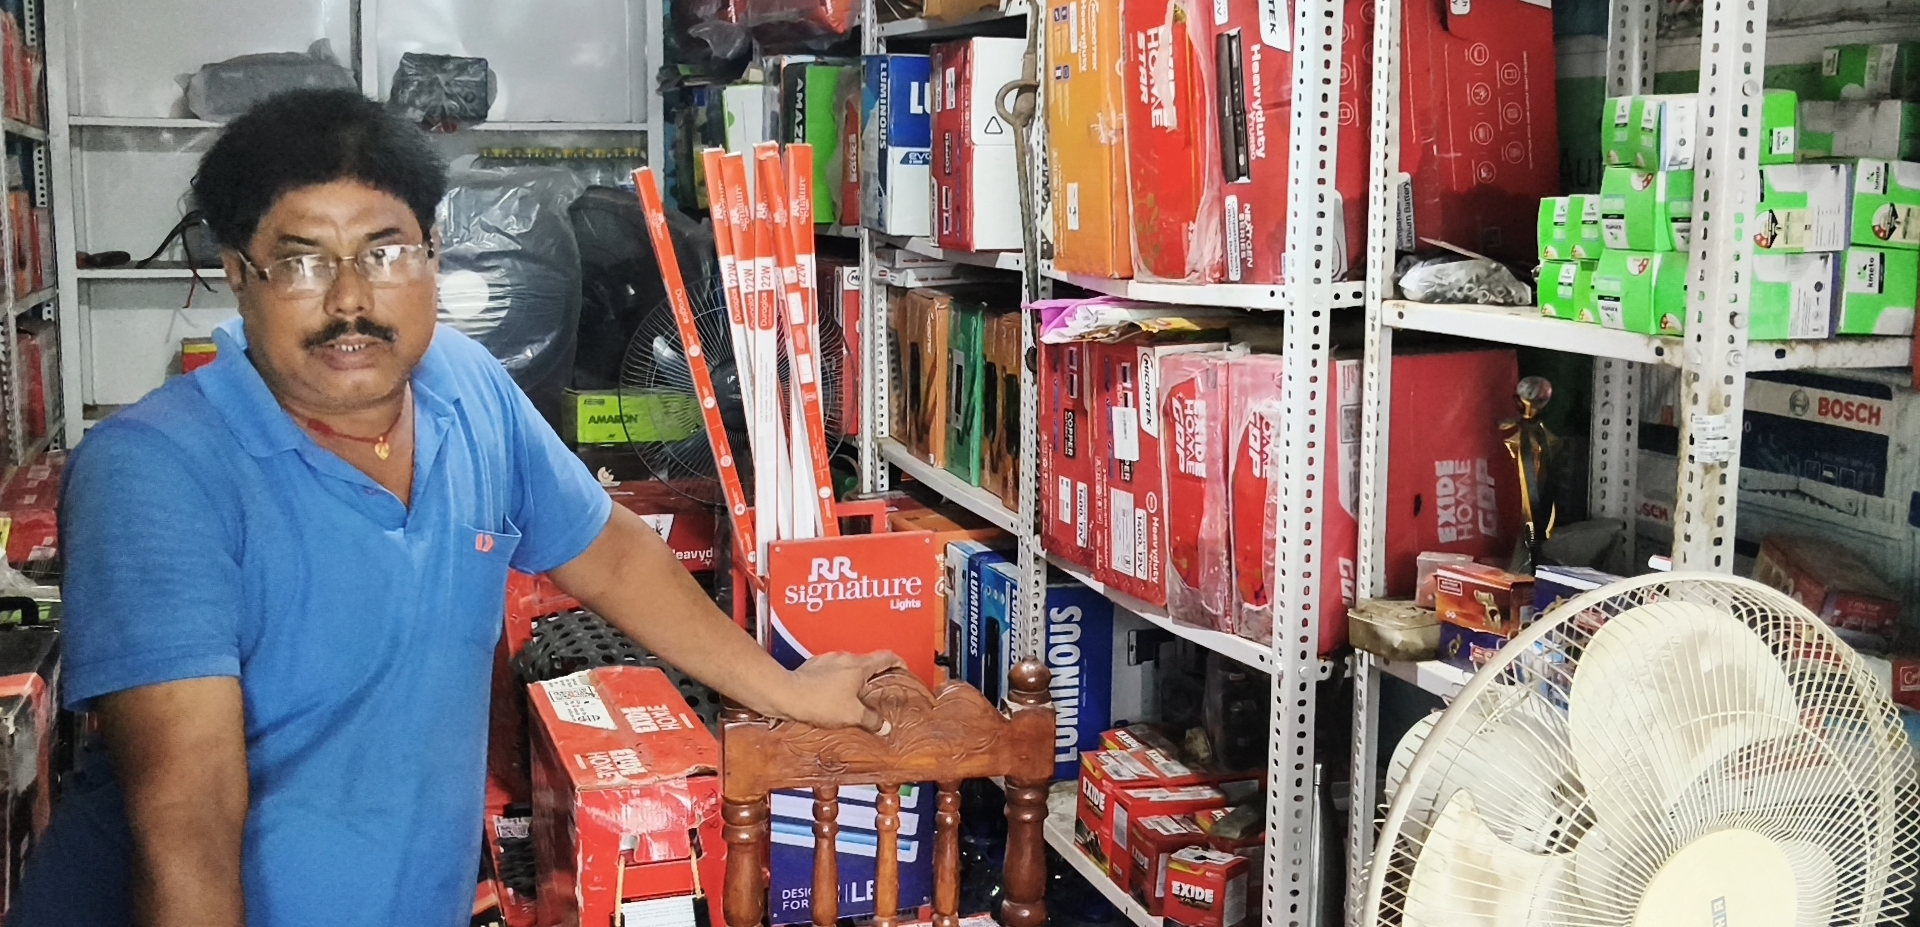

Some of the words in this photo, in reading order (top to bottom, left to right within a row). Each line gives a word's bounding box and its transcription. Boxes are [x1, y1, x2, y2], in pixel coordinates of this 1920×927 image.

[1137, 31, 1148, 104] STAR
[878, 62, 888, 150] LUMINOUS
[1251, 44, 1265, 159] Heavyduty
[848, 133, 858, 183] EXIDE
[798, 176, 810, 226] signature
[1403, 181, 1411, 213] Battery
[1238, 213, 1246, 259] SERIES
[1243, 203, 1253, 268] NEXTGEN
[727, 263, 738, 285] 22W
[743, 269, 755, 291] 22W
[761, 265, 771, 288] 22W
[1867, 256, 1875, 288] kineto
[1143, 356, 1153, 428] MICROTEK
[588, 414, 638, 425] AMARON
[1817, 397, 1882, 427] BOSCH
[1066, 411, 1074, 456] COPPER
[1184, 400, 1195, 475] HOME
[1194, 400, 1206, 478] EXIDE
[1435, 460, 1458, 543] EXIDE
[1454, 458, 1474, 541] HOME
[672, 546, 713, 561] eavyd
[1150, 516, 1160, 584] Heavyduty
[808, 556, 857, 583] RR
[785, 572, 922, 613] signature
[890, 597, 922, 610] Lights
[970, 570, 978, 657] LUMINOUS
[1049, 605, 1083, 763] LUMINOUS
[620, 706, 659, 733] EXIDE
[647, 704, 682, 731] HOME
[586, 751, 618, 780] HOME
[608, 748, 648, 776] EXIDE
[1083, 776, 1106, 812] EXIDE
[1132, 845, 1149, 871] EXIDE
[782, 899, 810, 911] FOR
[1171, 880, 1215, 904] EXIDE
